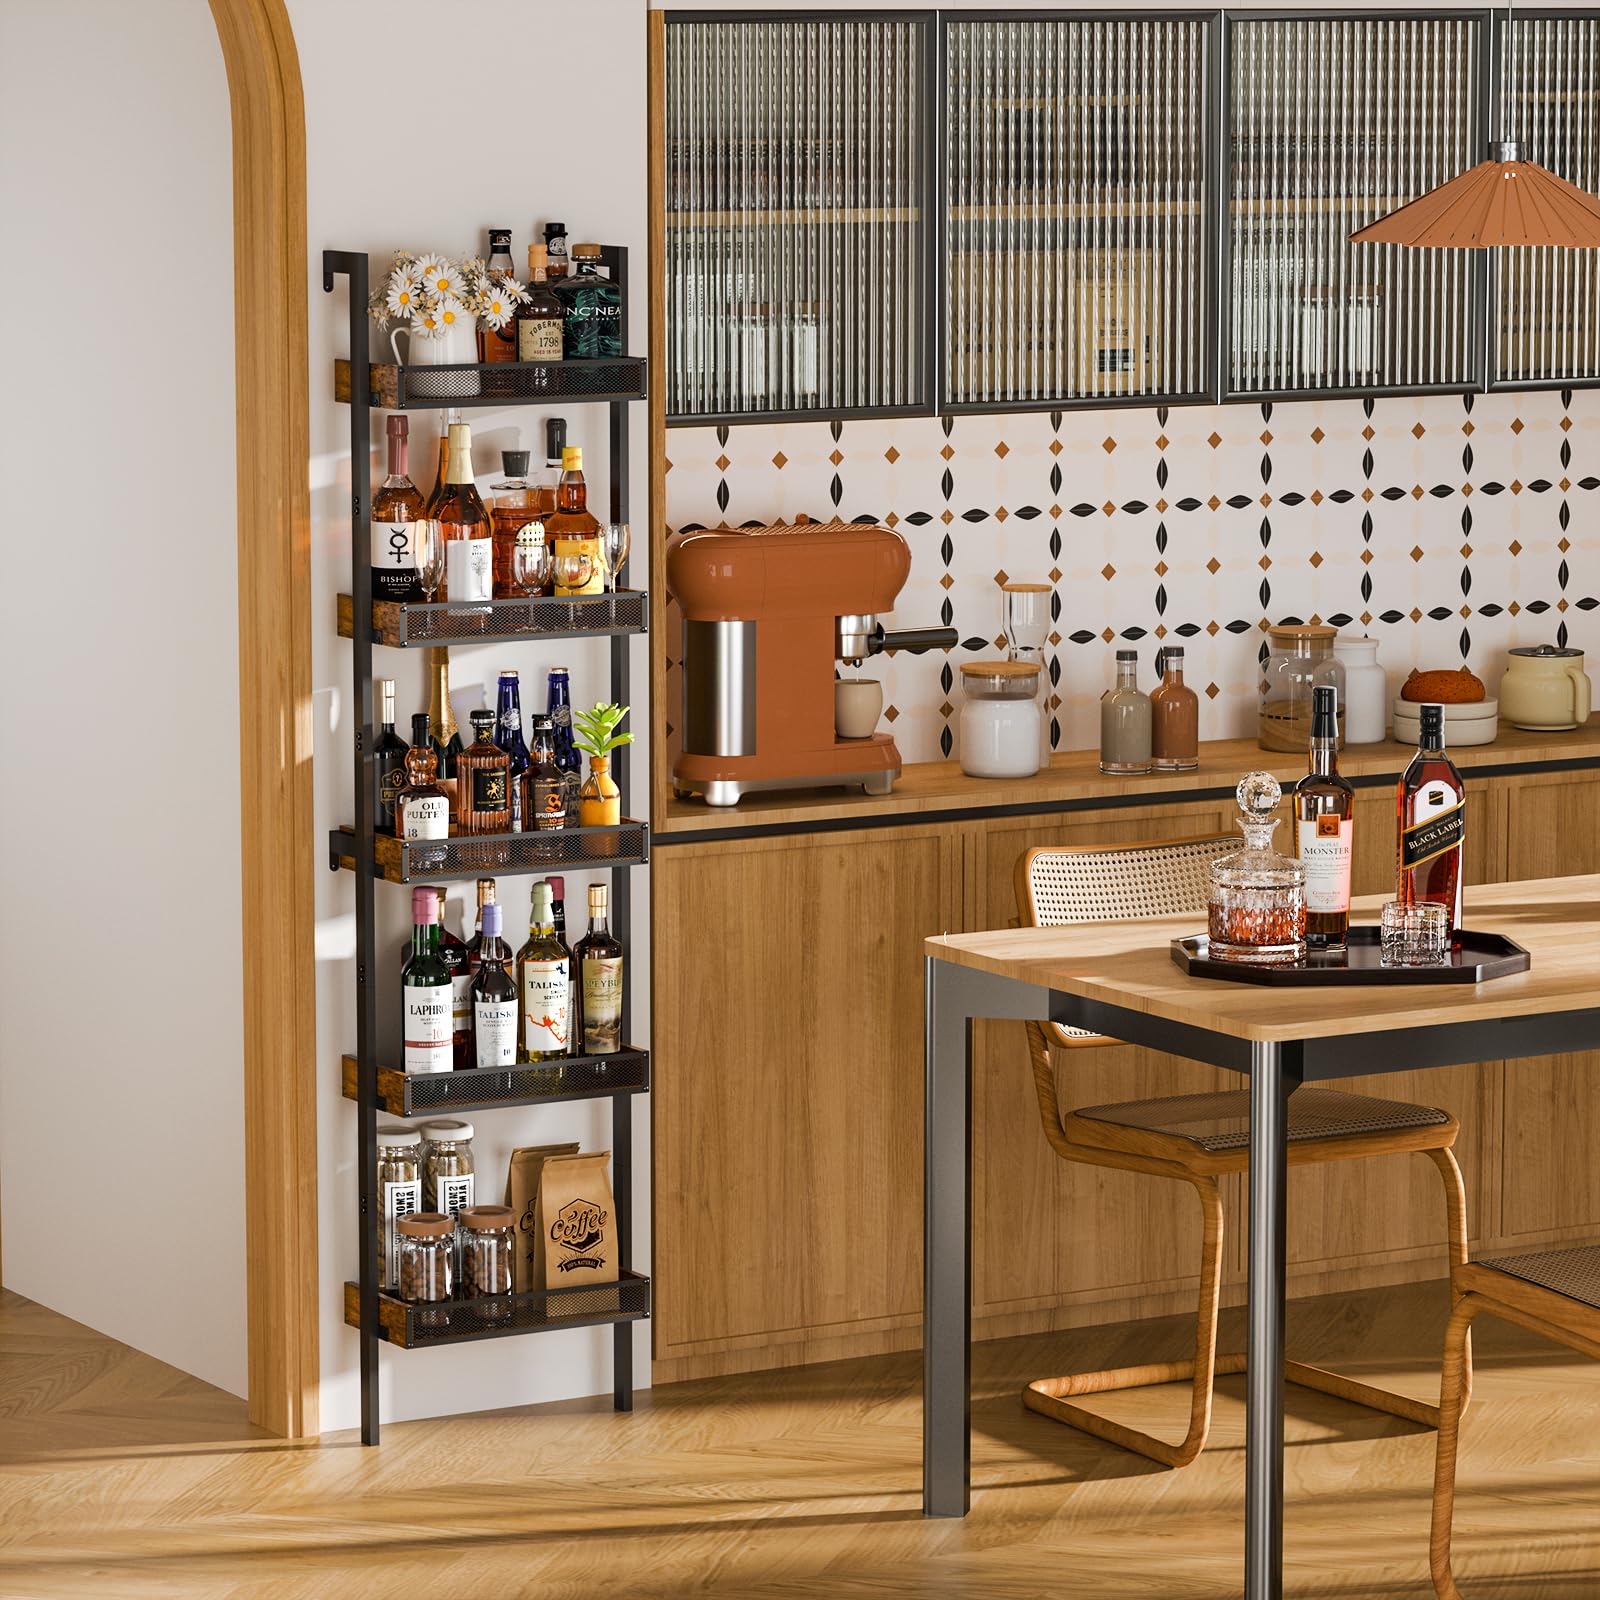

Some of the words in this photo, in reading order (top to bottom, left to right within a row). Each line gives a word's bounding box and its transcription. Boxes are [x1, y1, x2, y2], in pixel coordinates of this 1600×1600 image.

[539, 336, 560, 348] 1798
[421, 801, 444, 811] OLD
[407, 828, 418, 838] 18
[1408, 831, 1437, 850] BLACK
[1437, 818, 1464, 837] LABEL
[1304, 847, 1349, 855] MONSTER
[503, 1048, 511, 1056] 10
[550, 1208, 607, 1241] Coffee
